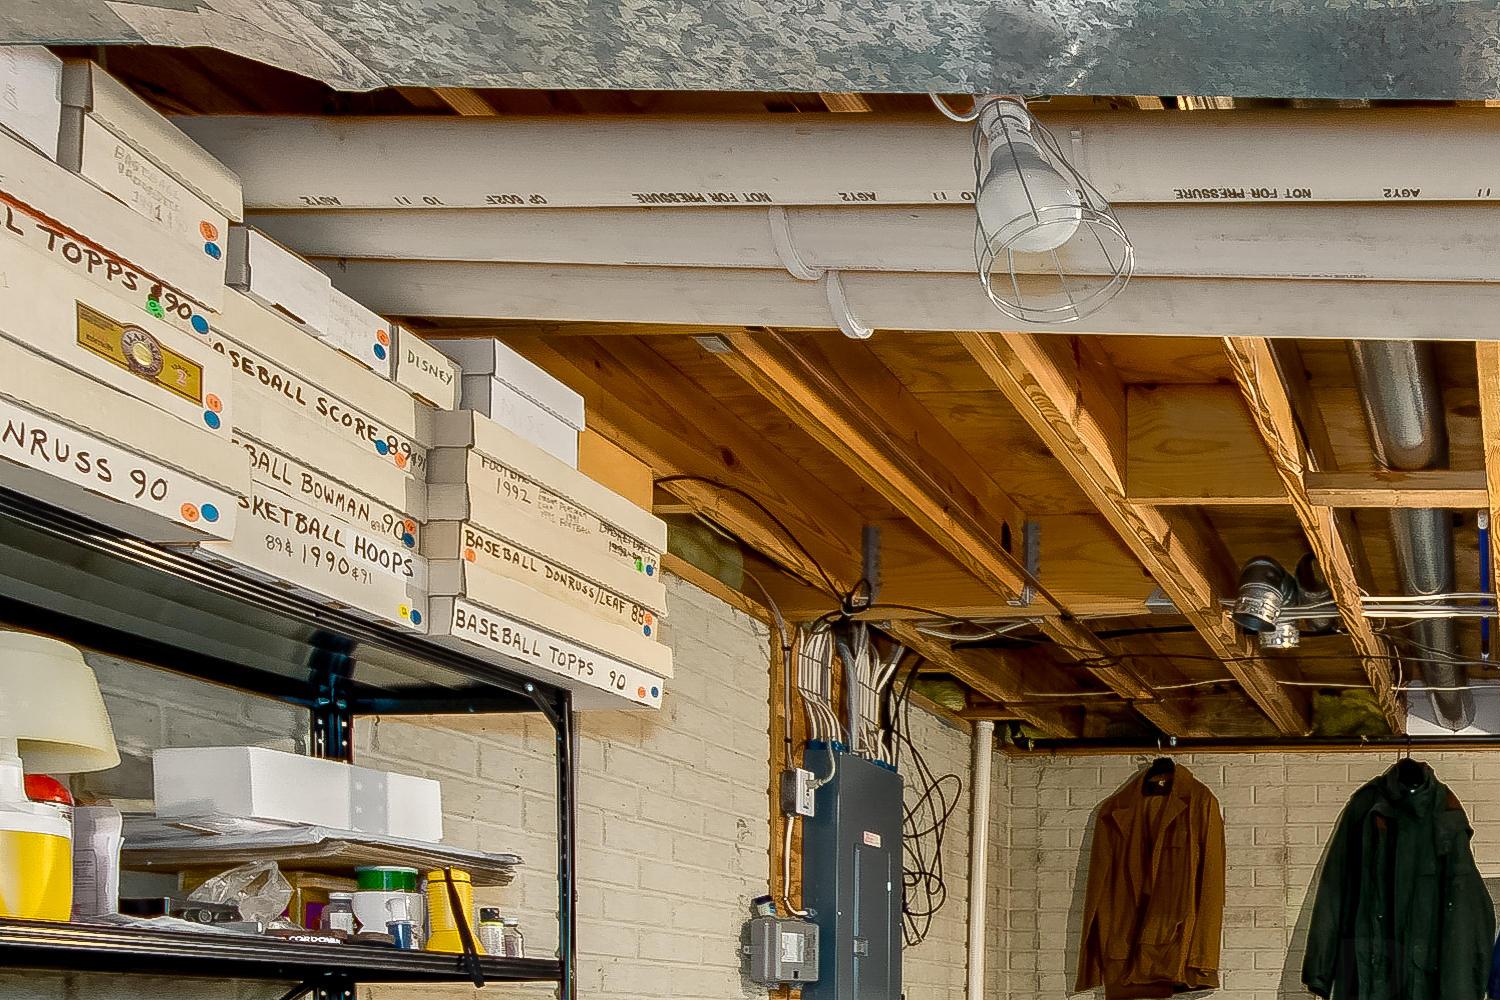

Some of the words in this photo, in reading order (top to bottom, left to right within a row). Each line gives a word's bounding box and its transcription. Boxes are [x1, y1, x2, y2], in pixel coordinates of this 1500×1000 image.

[528, 194, 548, 205] CP
[631, 192, 707, 204] PRESSURE
[708, 192, 739, 203] FOR
[742, 192, 773, 203] NOT
[1173, 188, 1246, 199] PRESSURE
[1251, 188, 1278, 199] FOR
[1284, 188, 1312, 199] NOT
[36, 223, 139, 291] TOPPS
[164, 292, 193, 320] 90
[406, 349, 454, 387] DISNEY
[209, 338, 307, 407] ASEBALL
[316, 396, 379, 443] SCORE
[386, 435, 412, 460] 89
[2, 418, 113, 484] NRUSS
[129, 468, 169, 502] 90
[300, 472, 371, 523] BOWMAN
[496, 477, 532, 505] 1992
[302, 543, 350, 575] 1990
[353, 534, 414, 578] HOOPS
[464, 529, 538, 573] BASEBALL
[455, 608, 541, 658] BASEBALL
[548, 645, 595, 677] TOPPS
[608, 670, 627, 691] 90
